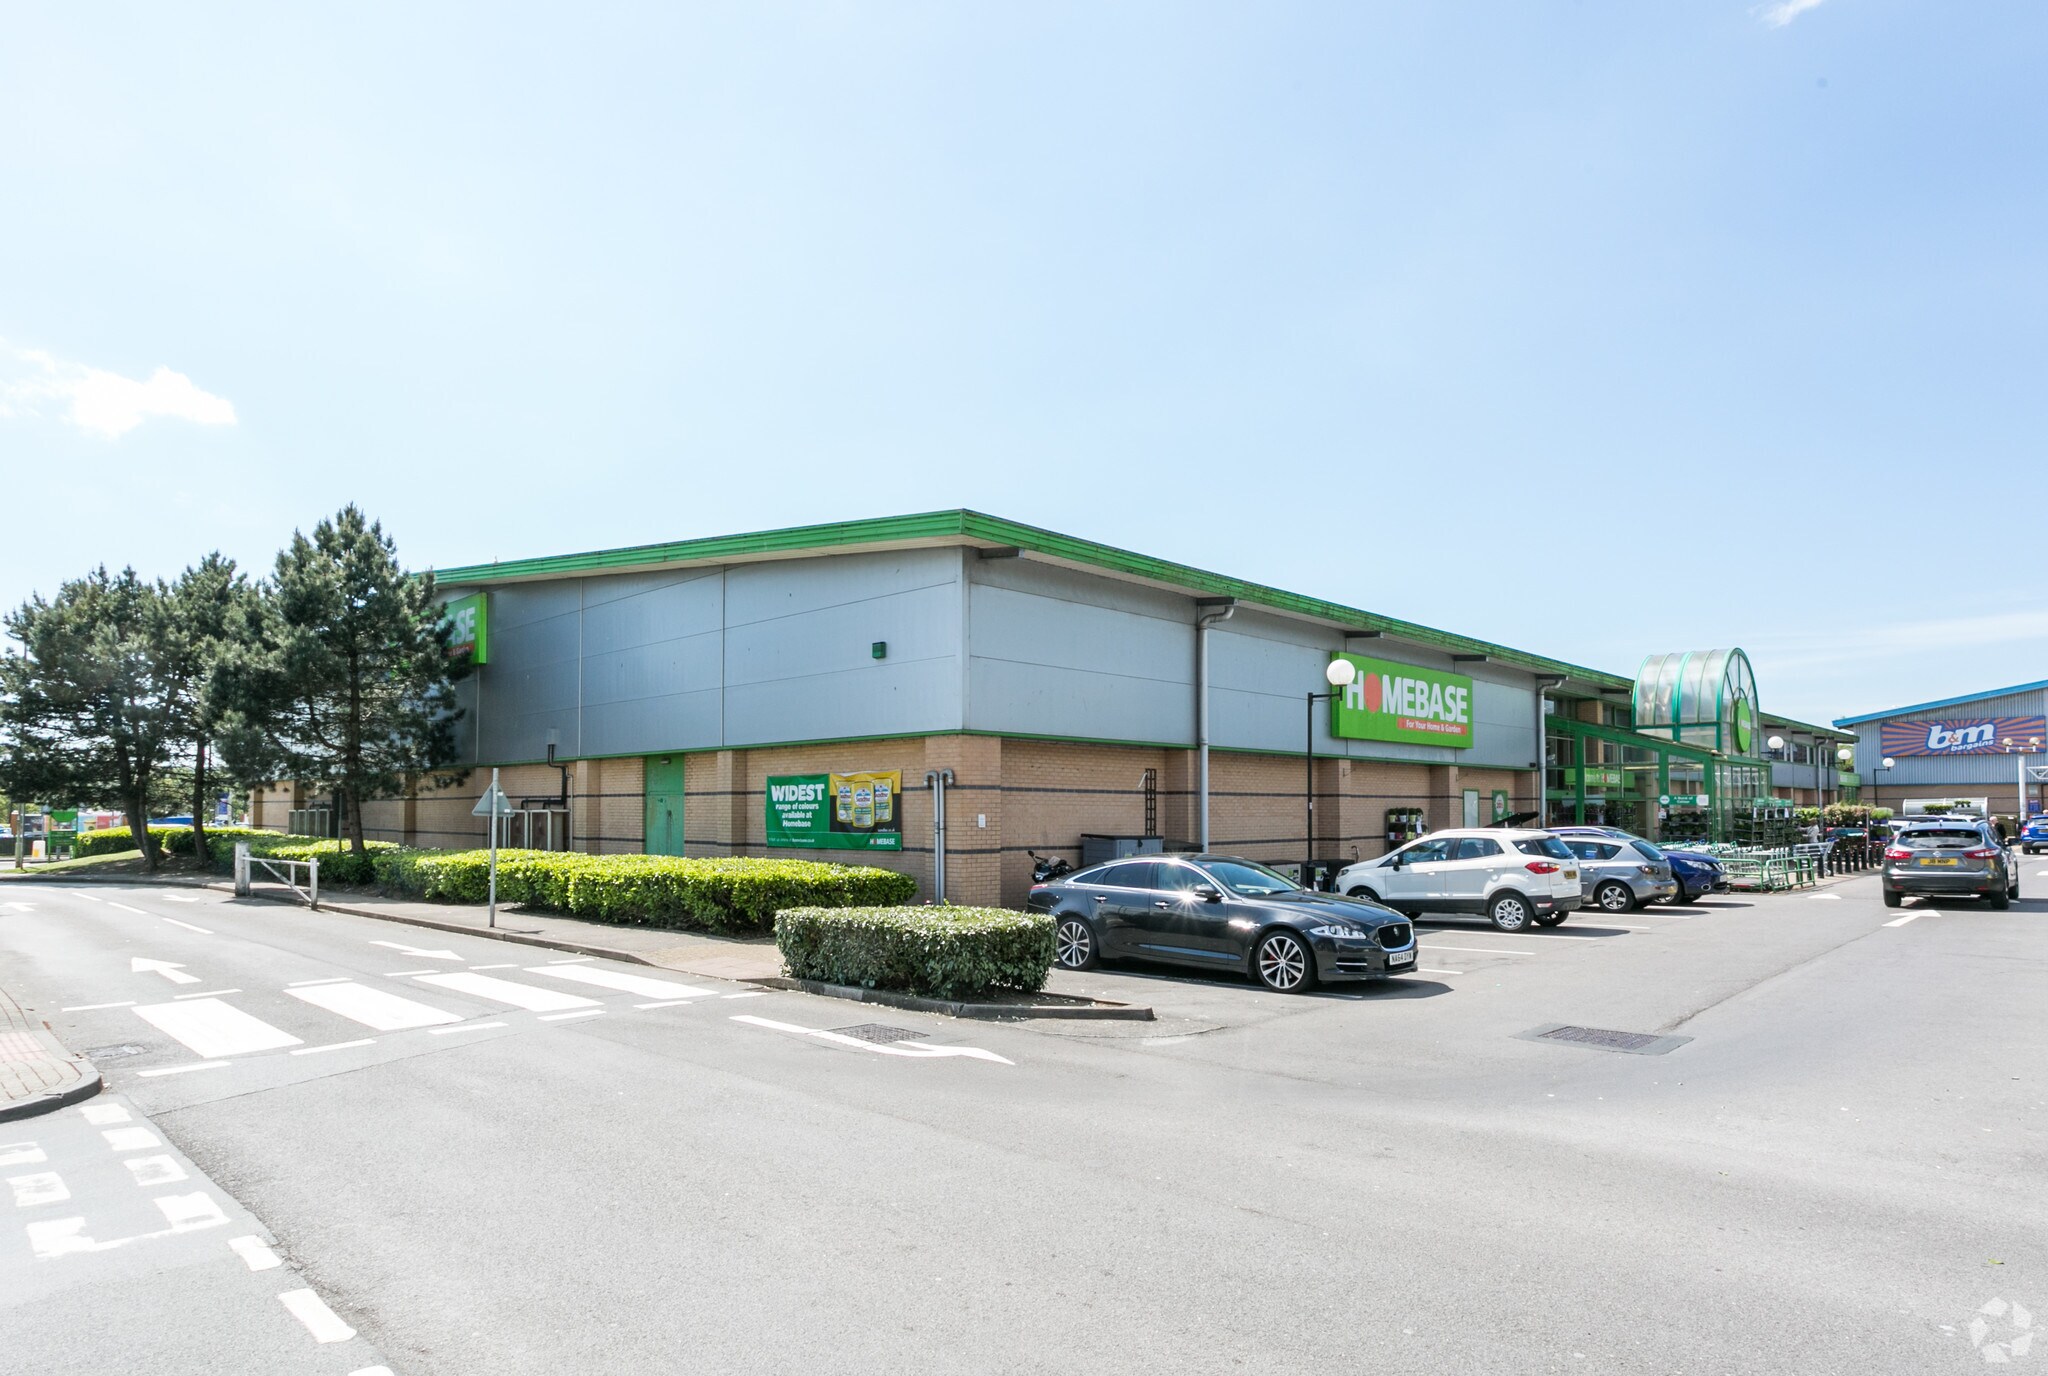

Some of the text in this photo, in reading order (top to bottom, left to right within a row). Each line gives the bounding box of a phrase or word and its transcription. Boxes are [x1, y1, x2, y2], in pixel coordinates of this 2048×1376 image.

[1346, 670, 1468, 723] HOMEBASE
[1406, 719, 1414, 728] For
[1415, 720, 1426, 729] Your
[1426, 721, 1440, 731] Home
[1445, 724, 1461, 733] Garden
[1927, 723, 1995, 750] b&m
[1950, 739, 1994, 752] bargains
[771, 783, 825, 802] WIDEST
[776, 803, 791, 811] range
